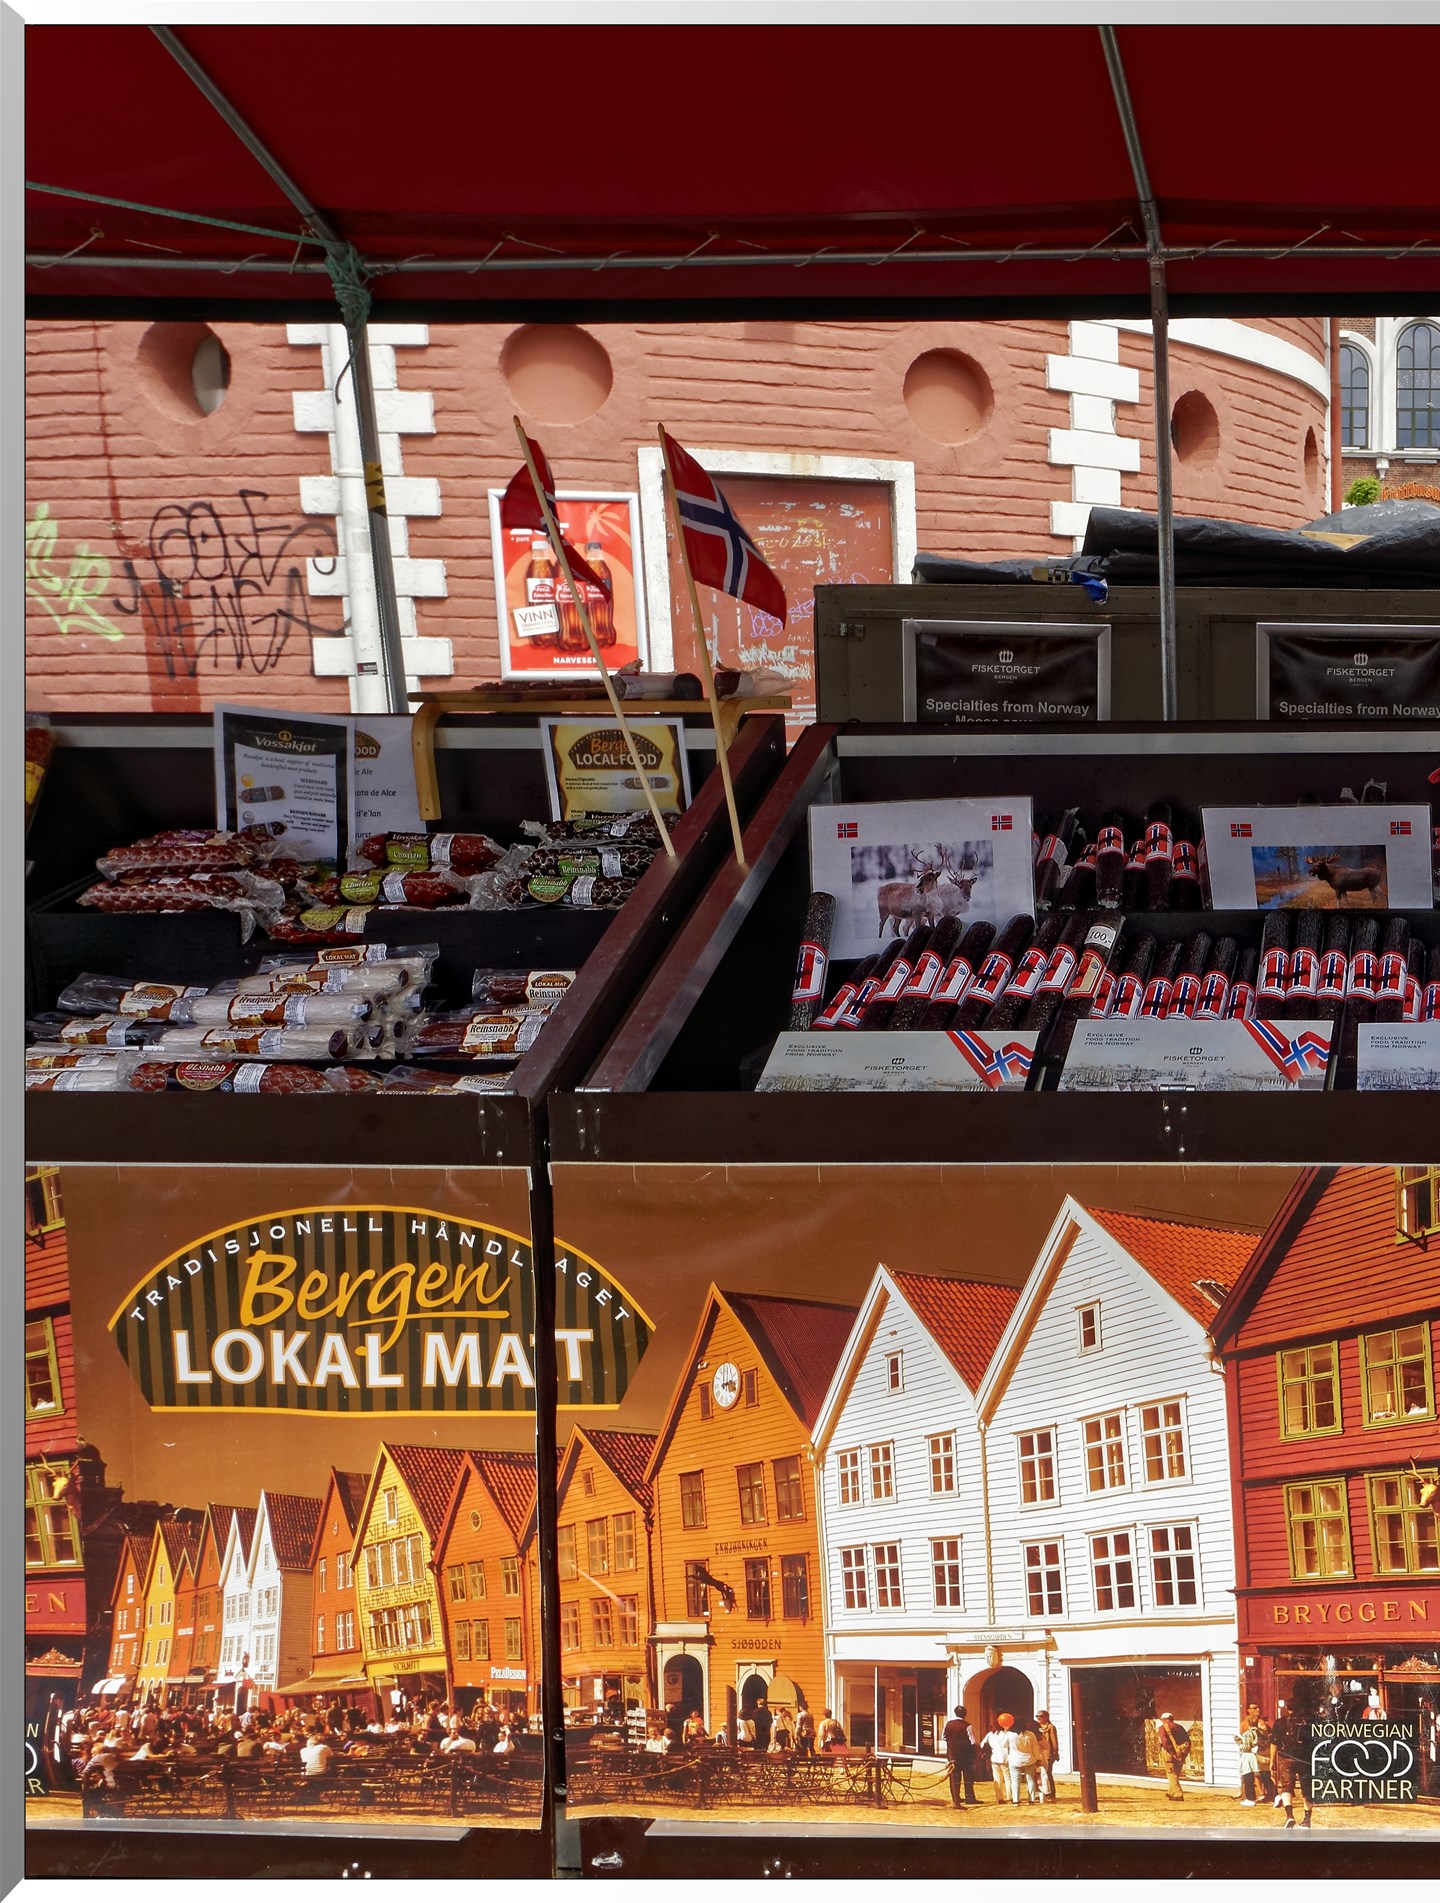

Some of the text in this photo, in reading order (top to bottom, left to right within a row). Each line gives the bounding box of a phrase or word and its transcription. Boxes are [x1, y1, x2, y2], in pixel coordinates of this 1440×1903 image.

[518, 609, 554, 623] VINN
[971, 664, 1041, 674] FISKETORGET
[1326, 667, 1396, 677] FISKETORGET
[925, 698, 1090, 717] Specialties from Norway
[1279, 701, 1353, 716] Specialties
[1357, 703, 1389, 716] from
[254, 735, 318, 753] Vossakjøt
[355, 747, 377, 755] OOD
[576, 754, 618, 765] LOCAL
[370, 789, 380, 797] de
[381, 789, 396, 797] Alce
[1089, 930, 1112, 944] 100,-
[529, 989, 567, 999] Reinsnab
[470, 1024, 514, 1033] Reinsnabb
[131, 1218, 631, 1323] TRADISJONELL HÅNDLAGET
[241, 1251, 511, 1355] Bergen
[173, 1329, 595, 1388] LOKAL MAT
[1273, 1599, 1429, 1625] BRYGGEN
[731, 1639, 782, 1650] SJØBODEN
[1311, 1722, 1414, 1739] NORWEGIAN
[1311, 1739, 1414, 1778] FOOD
[1311, 1779, 1413, 1800] PARTNER
